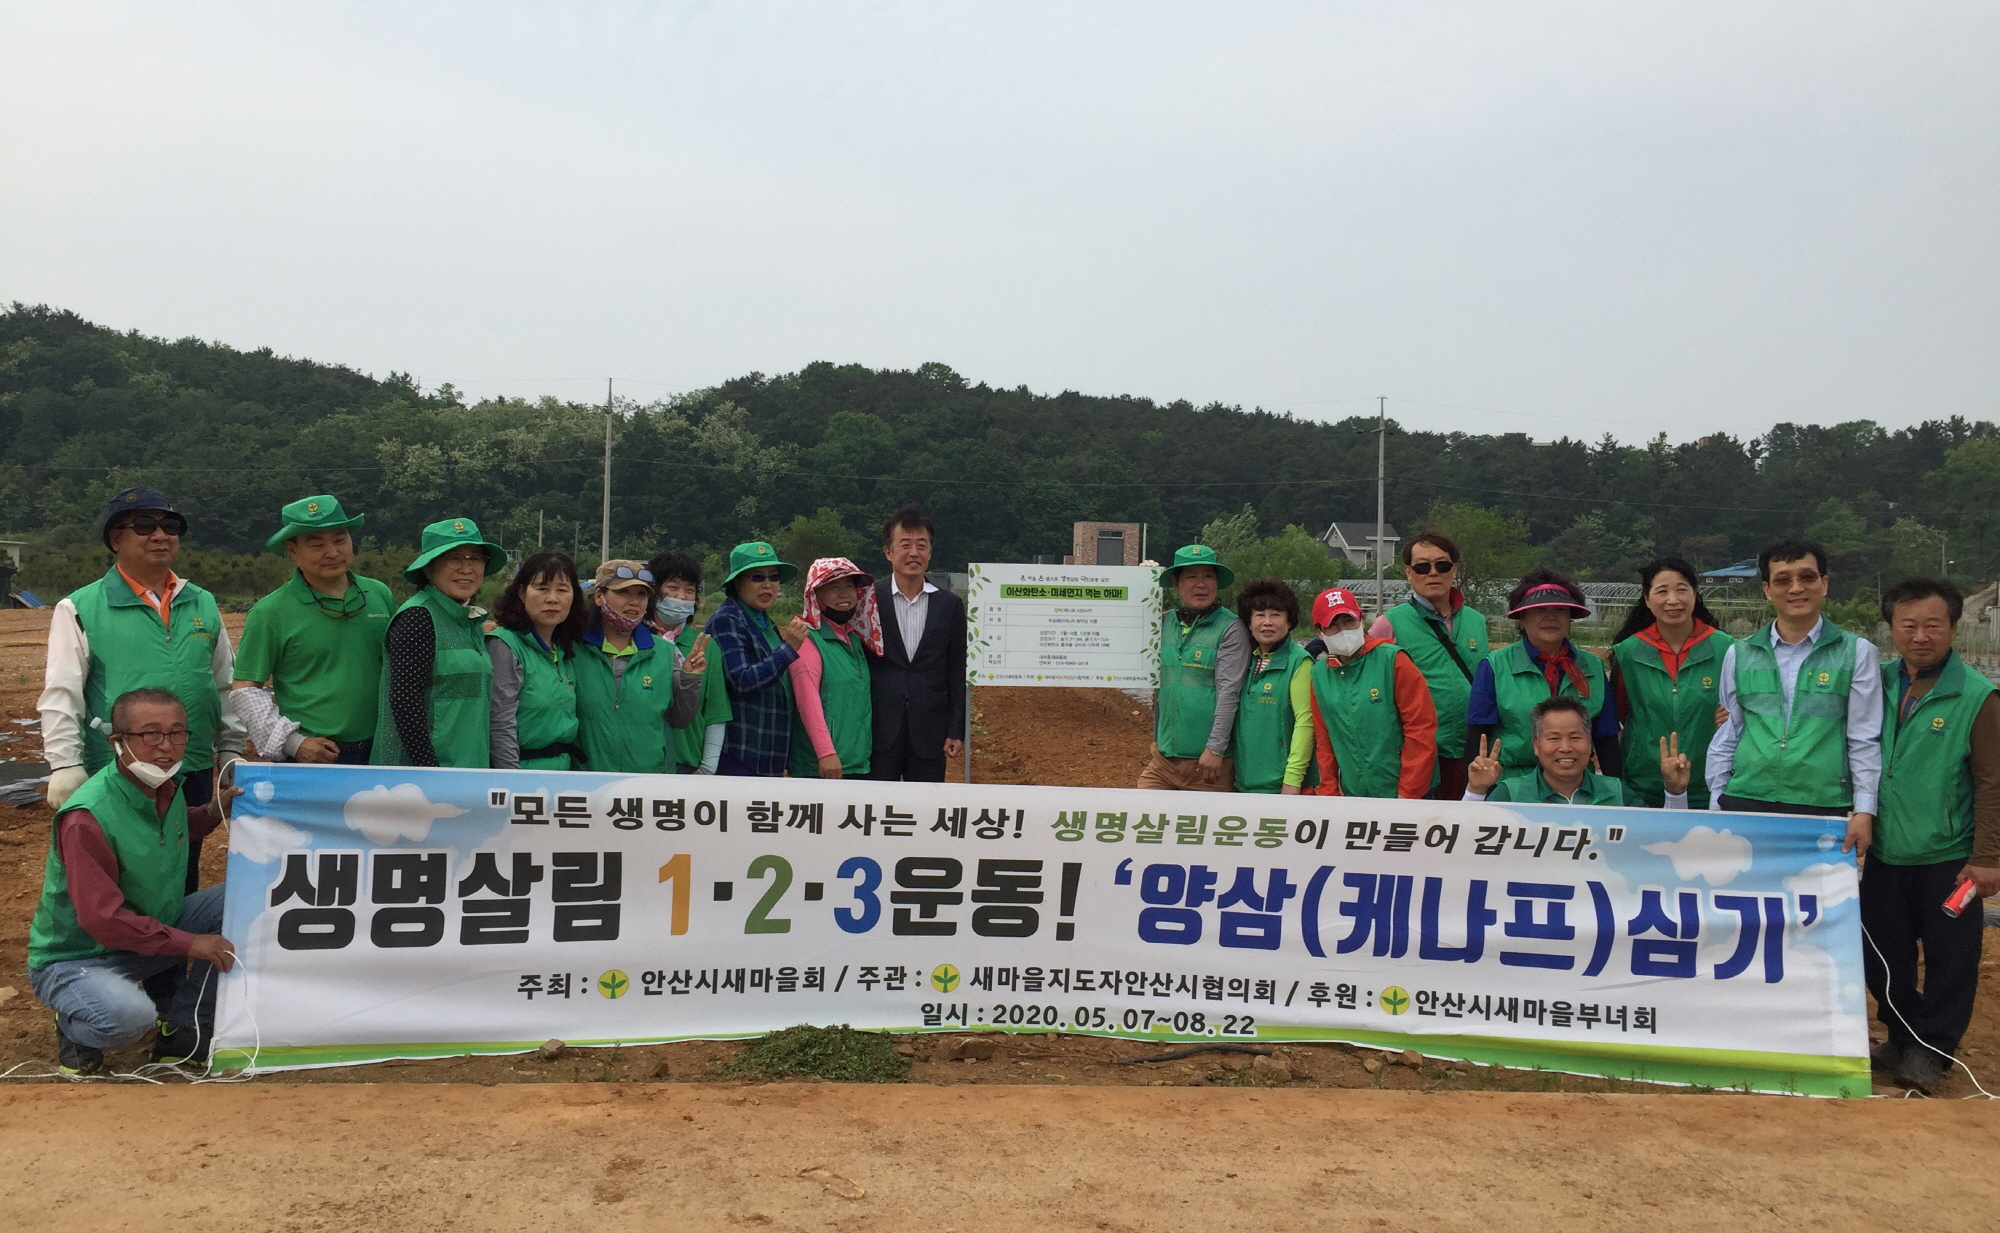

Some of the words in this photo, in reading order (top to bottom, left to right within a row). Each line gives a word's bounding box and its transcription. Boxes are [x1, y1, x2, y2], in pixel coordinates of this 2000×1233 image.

[1103, 589, 1122, 598] 하마!
[1325, 591, 1345, 607] H
[606, 797, 728, 833] 생명이
[746, 800, 823, 835] 함께
[838, 803, 917, 837] 사는
[930, 807, 1025, 840] 세상!
[1050, 810, 1329, 850] 생명살림운동이
[1344, 820, 1459, 854] 만들어
[270, 851, 623, 951] 생명살림
[641, 966, 825, 996] 안산시새마을회
[969, 966, 1276, 1005] 새마을지도자안산시협의회
[1414, 990, 1657, 1035] 안산시새마을부녀회
